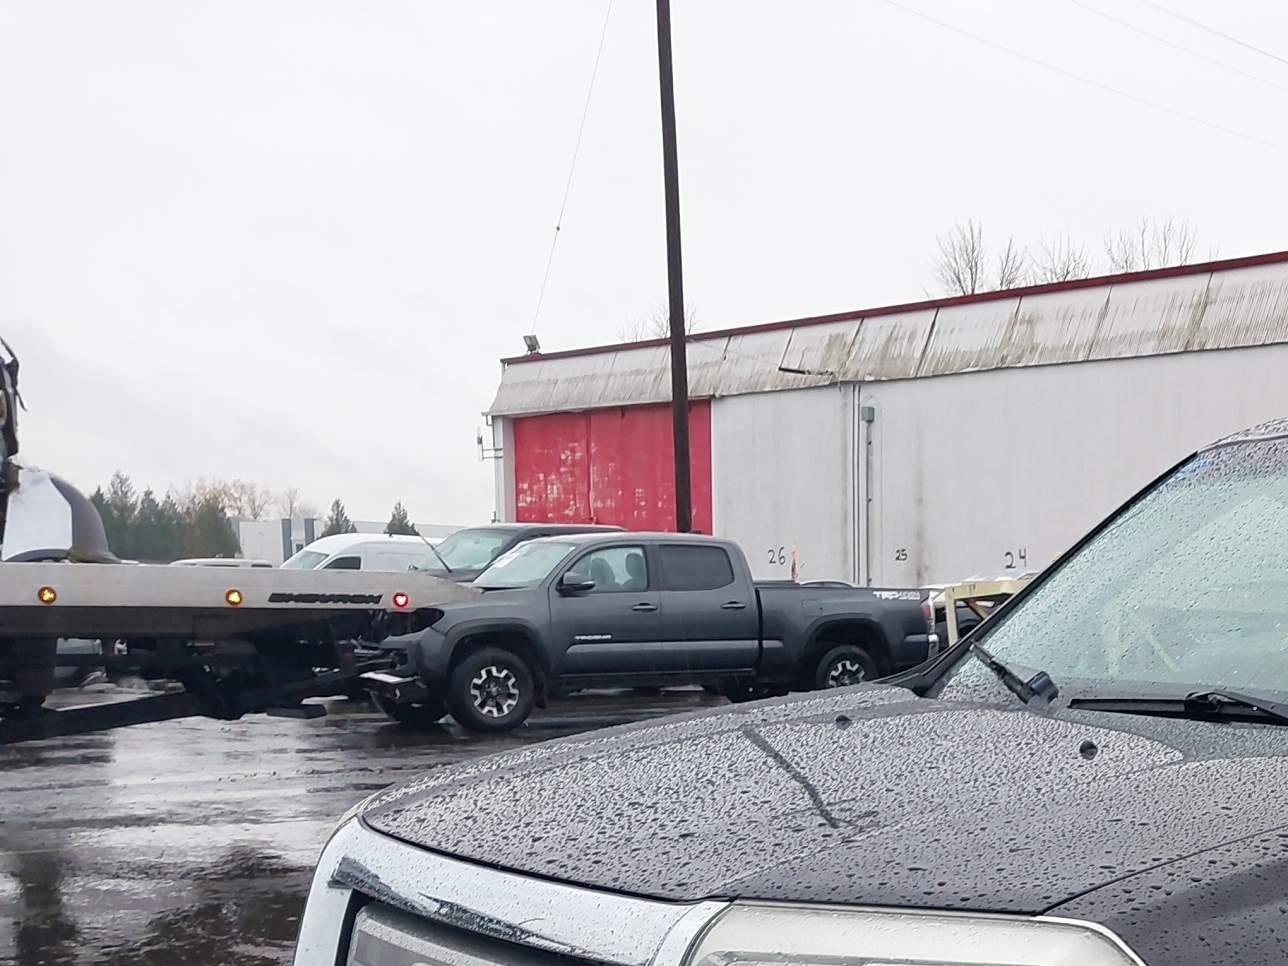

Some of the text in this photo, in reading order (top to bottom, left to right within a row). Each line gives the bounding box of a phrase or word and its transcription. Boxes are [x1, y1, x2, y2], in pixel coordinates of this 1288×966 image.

[767, 546, 787, 566] 26
[895, 548, 908, 562] 25
[1004, 547, 1028, 569] 24
